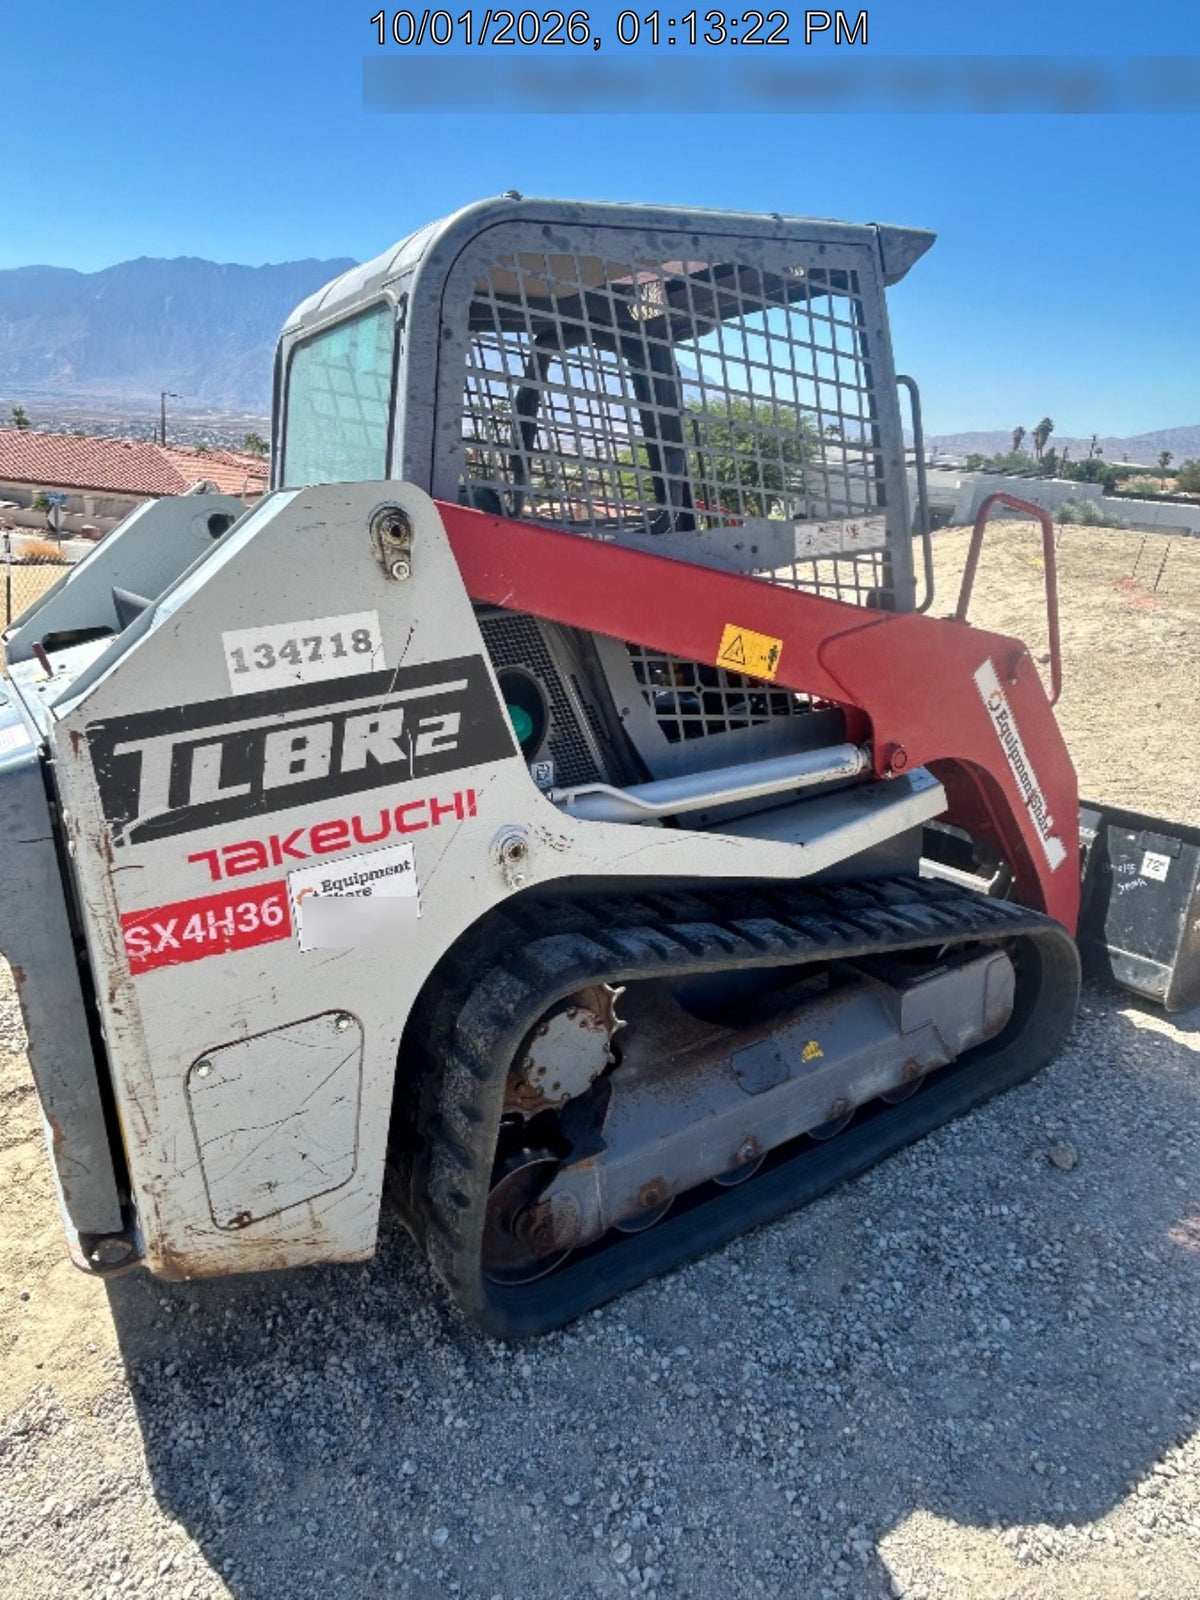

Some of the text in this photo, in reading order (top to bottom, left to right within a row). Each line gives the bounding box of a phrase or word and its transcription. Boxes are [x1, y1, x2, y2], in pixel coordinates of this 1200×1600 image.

[230, 628, 372, 674] 134718
[321, 859, 412, 893] Equipment
[124, 896, 284, 959] SX4H36
